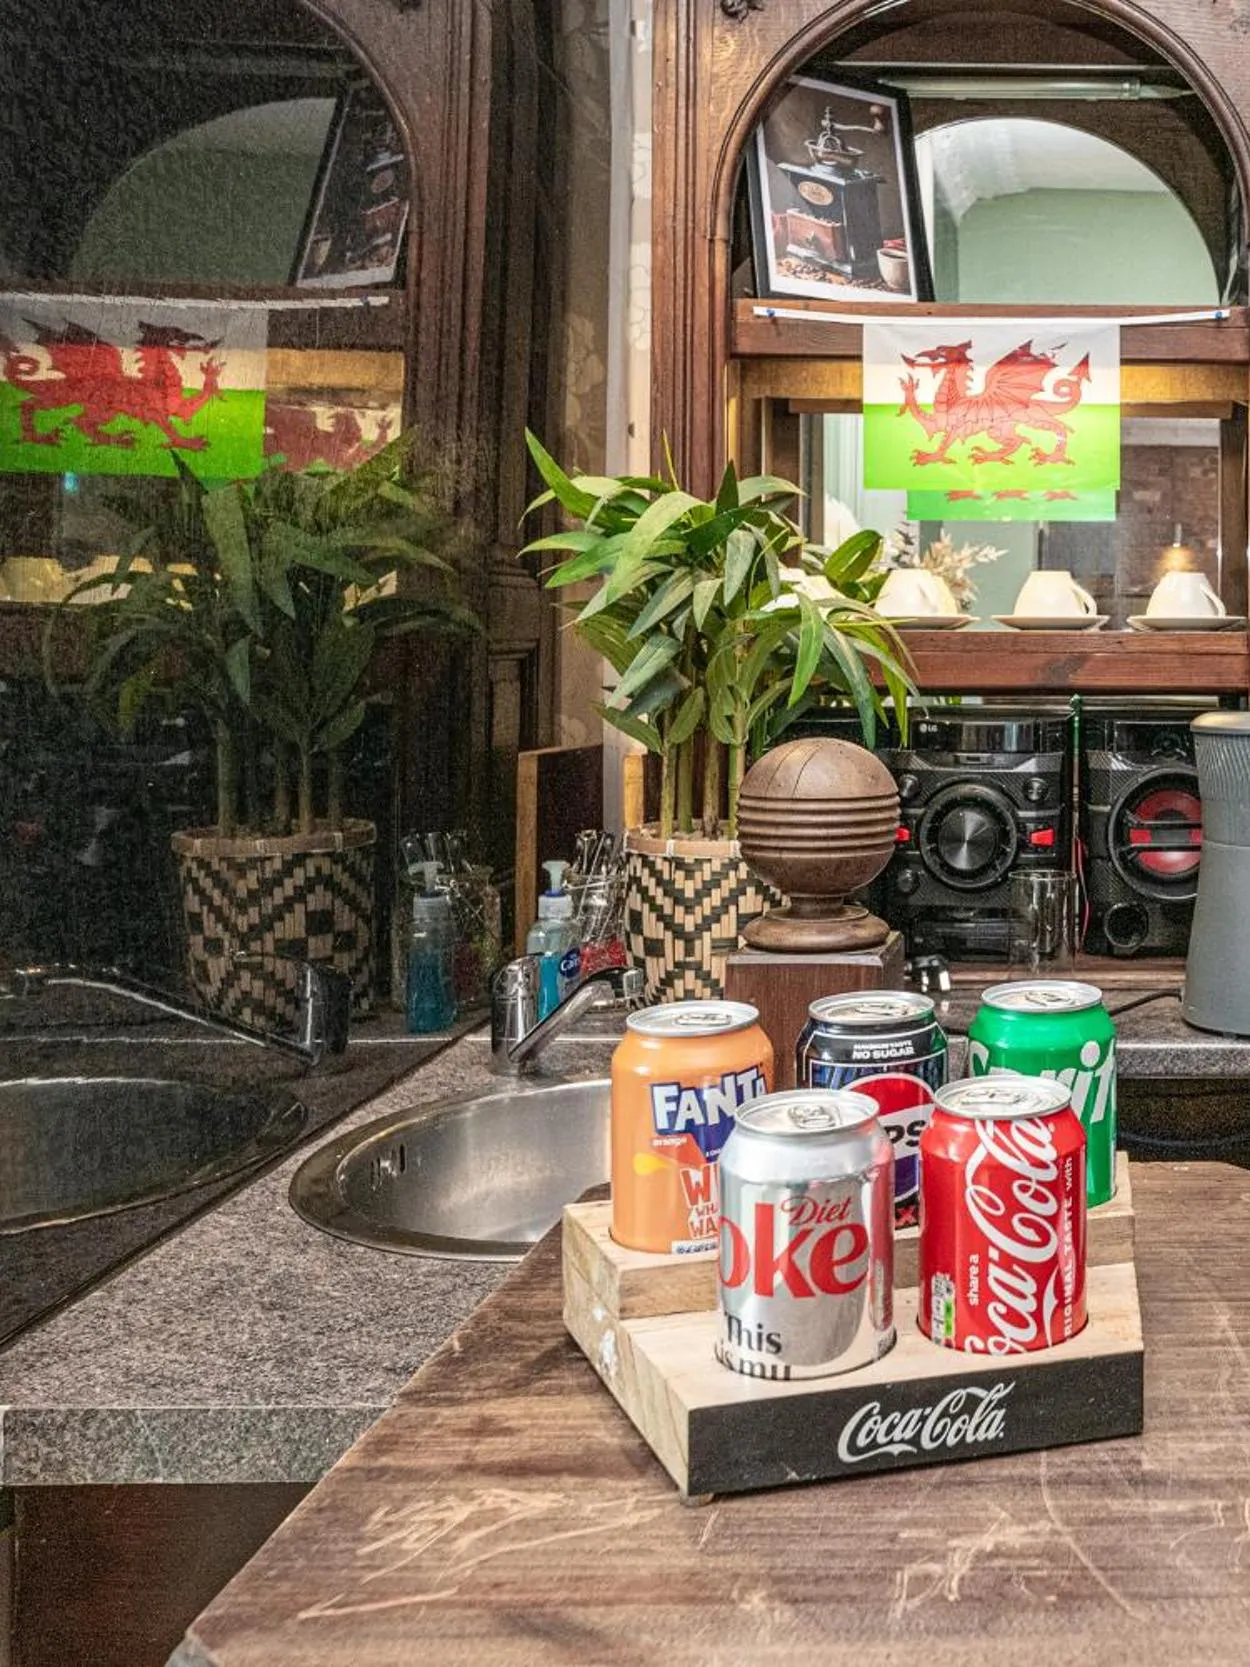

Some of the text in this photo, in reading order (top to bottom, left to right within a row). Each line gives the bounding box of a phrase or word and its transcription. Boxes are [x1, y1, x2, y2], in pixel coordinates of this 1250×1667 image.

[851, 1046, 915, 1060] NO SUGAR
[1064, 1156, 1074, 1191] with
[781, 1196, 852, 1227] Diet
[718, 1202, 869, 1299] oke
[968, 1254, 980, 1306] share a
[1063, 1259, 1074, 1338] RIGINAL
[837, 1381, 1017, 1463] Coca-Cola
